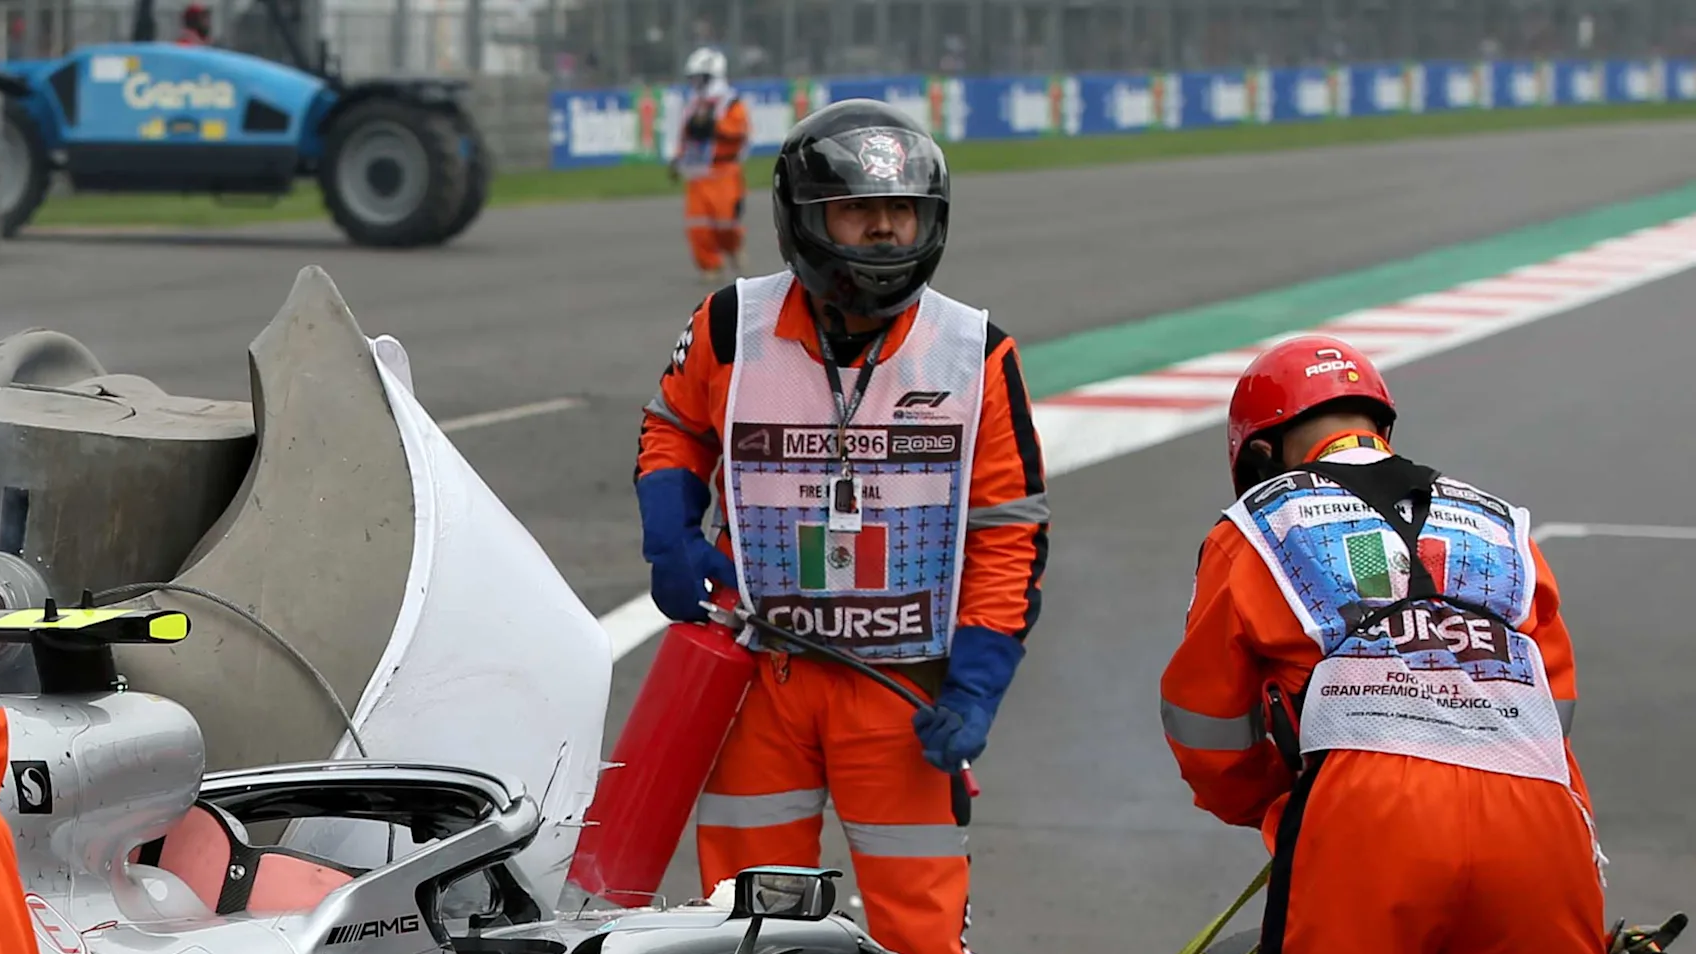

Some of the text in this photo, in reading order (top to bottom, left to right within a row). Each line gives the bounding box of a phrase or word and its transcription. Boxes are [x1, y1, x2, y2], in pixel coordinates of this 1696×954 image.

[1305, 360, 1358, 377] RODA
[786, 433, 956, 454] MEX1396 2019
[799, 484, 823, 499] FIRE
[1428, 509, 1480, 528] RSHAL
[766, 602, 924, 638] COURSE
[1357, 608, 1496, 653] URSE
[1320, 685, 1360, 697] GRAN
[1363, 683, 1419, 698] PREMIO
[1452, 685, 1460, 694] 1
[358, 914, 419, 940] AMG
